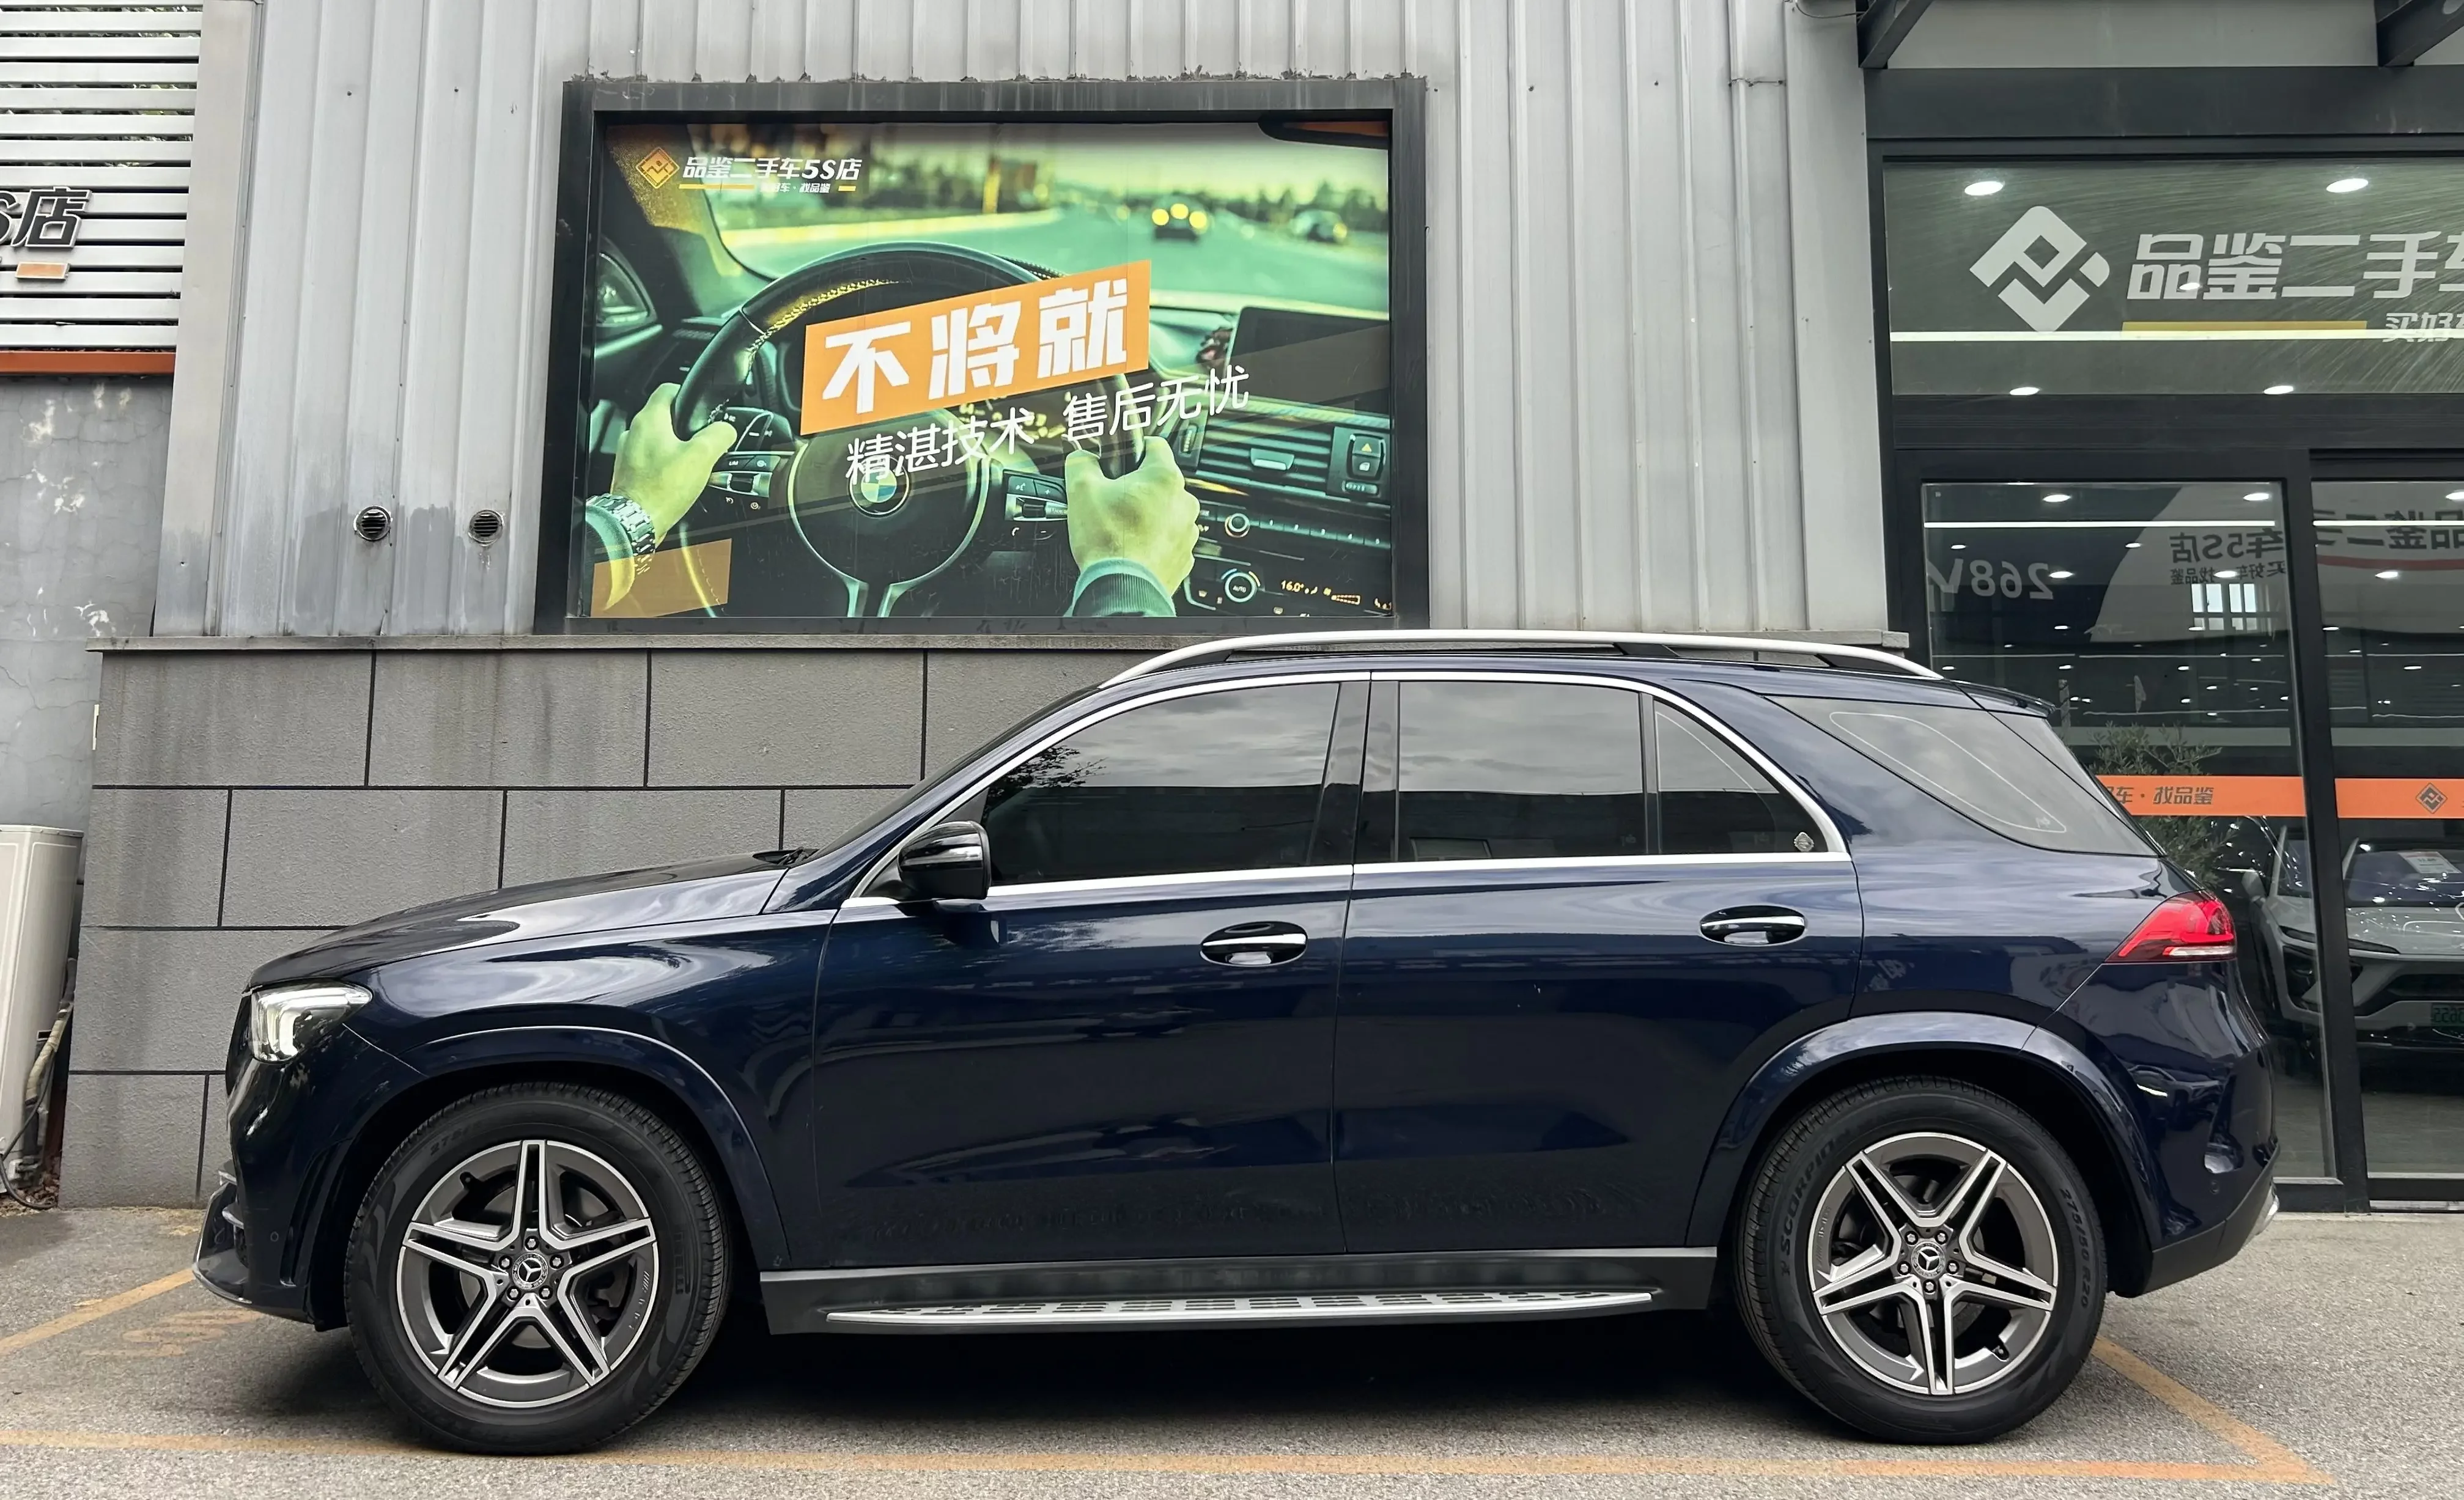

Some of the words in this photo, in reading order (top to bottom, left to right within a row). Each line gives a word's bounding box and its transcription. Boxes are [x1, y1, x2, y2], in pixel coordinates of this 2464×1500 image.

[682, 156, 863, 180] 品鉴二手车5S店
[2126, 230, 2464, 300] 品鉴二手
[822, 279, 1127, 414] 不将就
[2382, 312, 2464, 342] 买好
[845, 406, 1035, 485] 精湛技术
[1061, 364, 1250, 443] 售后无忧
